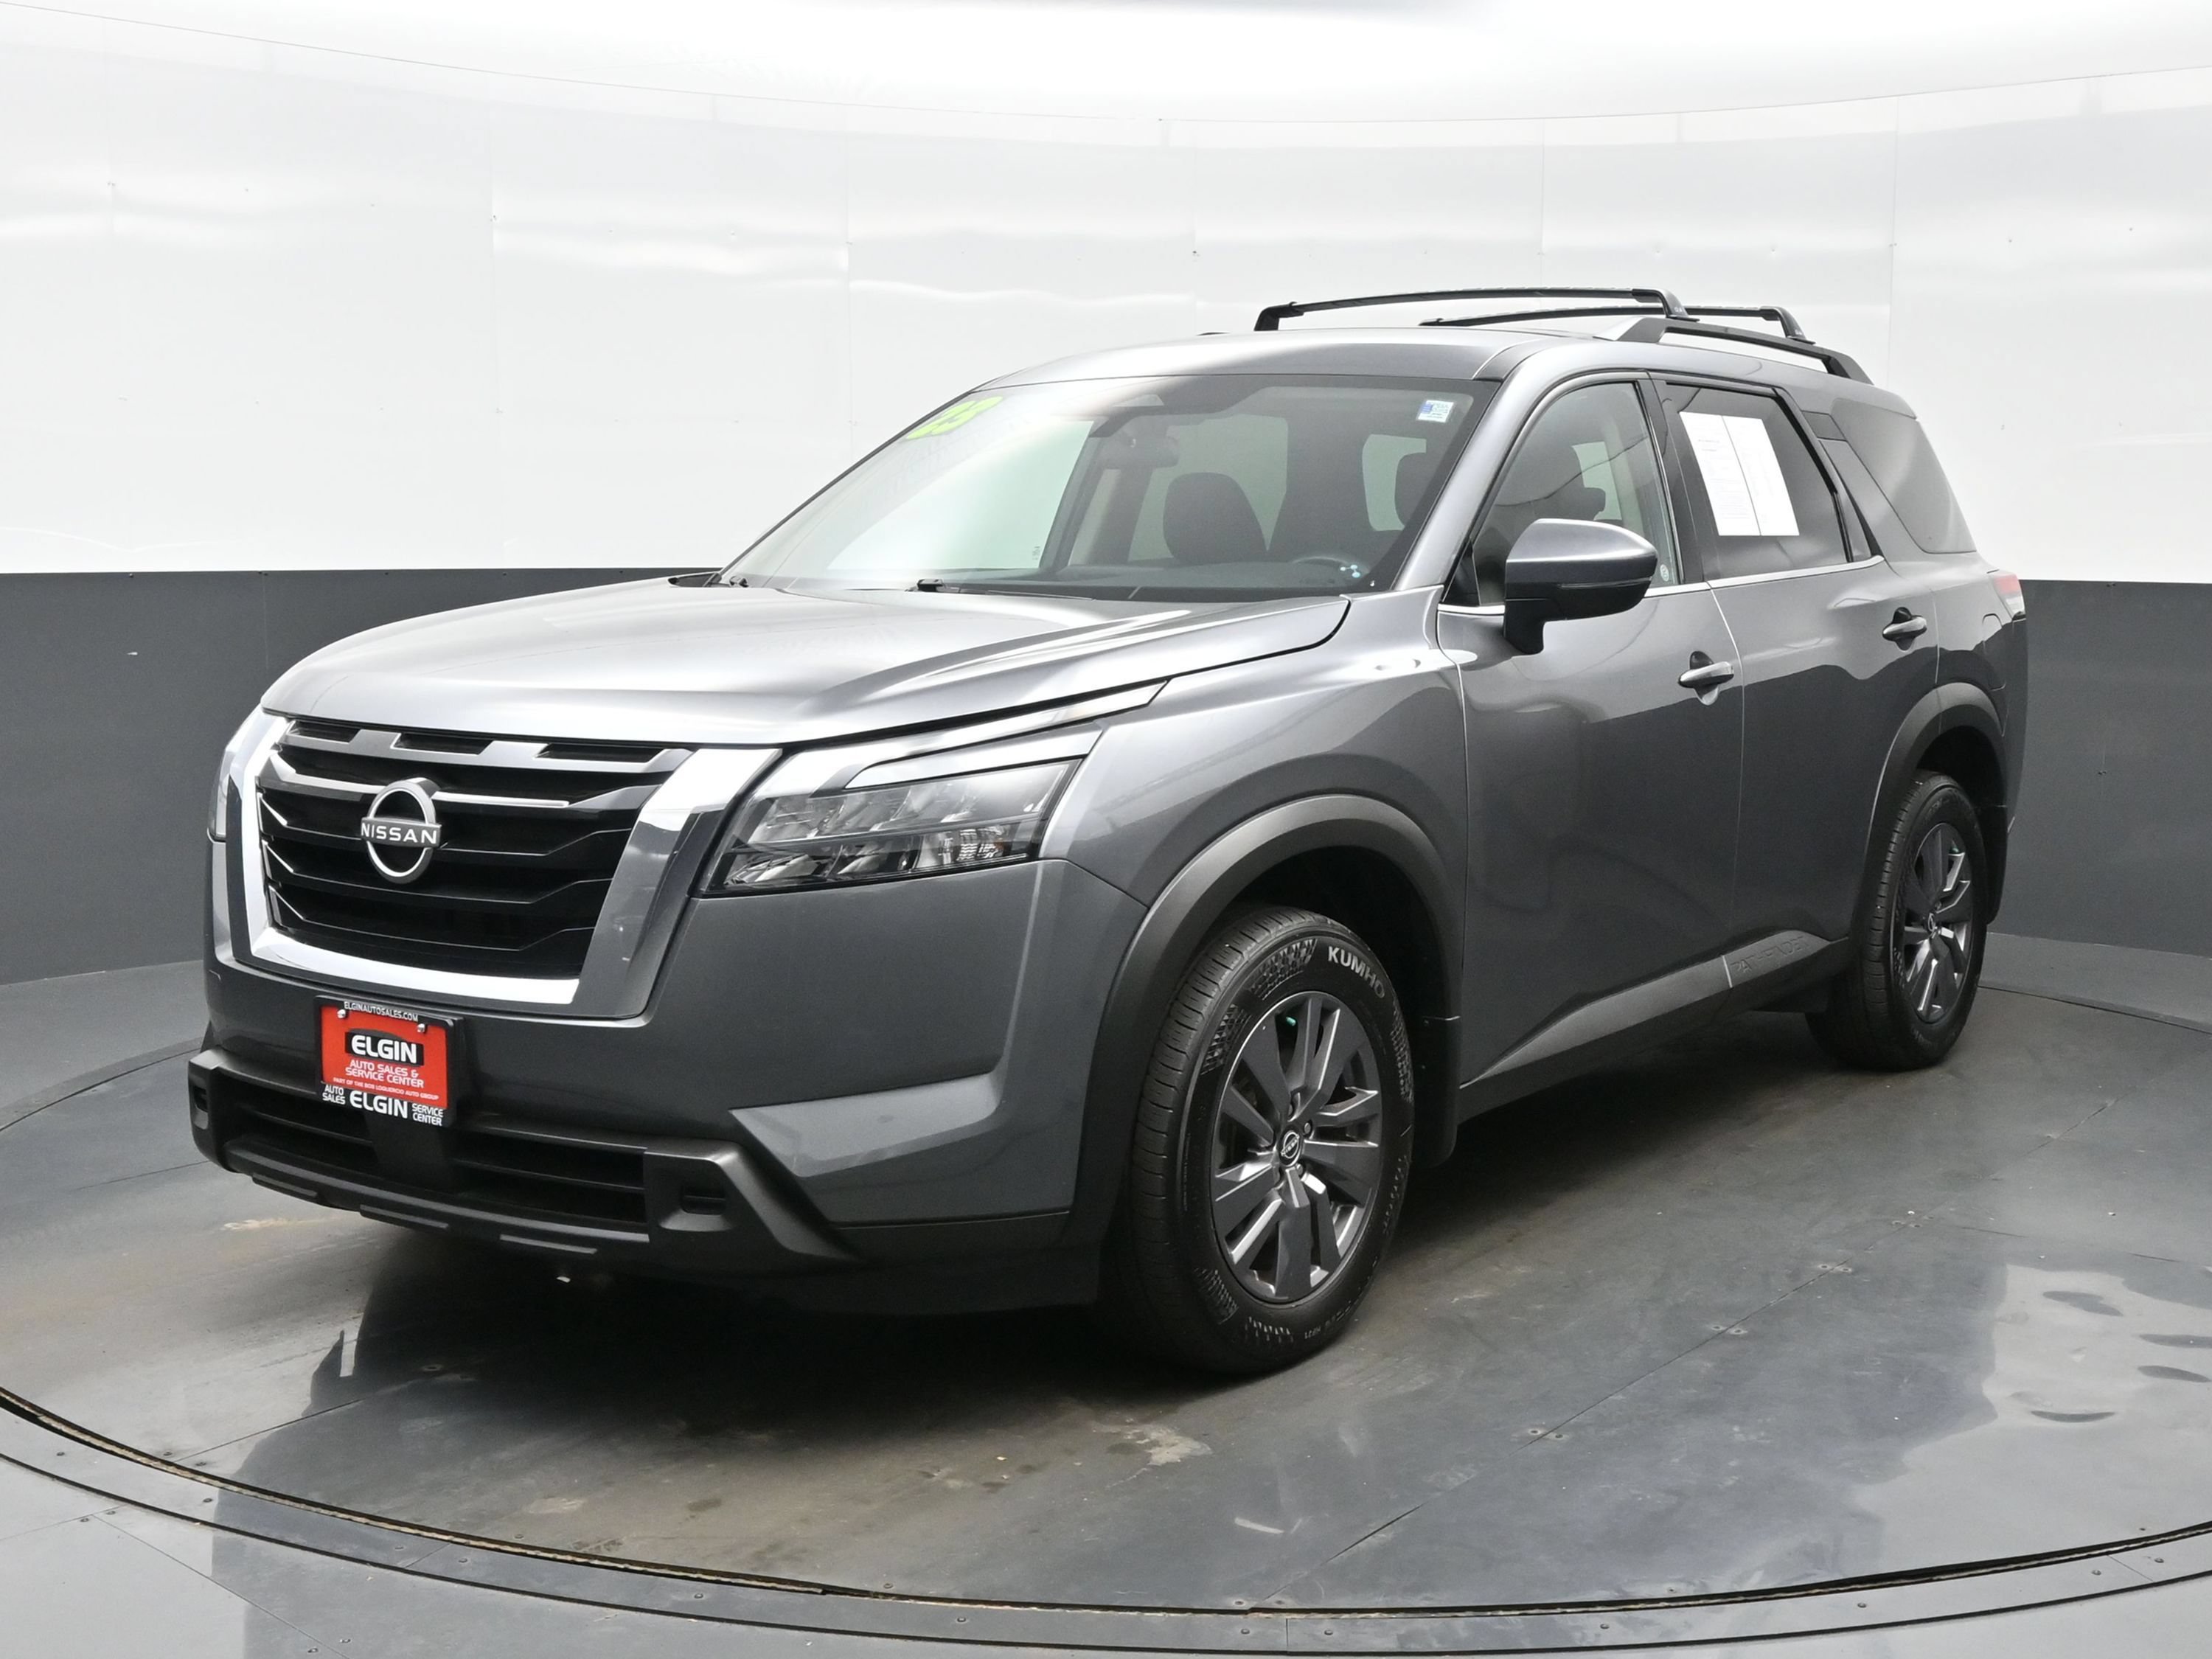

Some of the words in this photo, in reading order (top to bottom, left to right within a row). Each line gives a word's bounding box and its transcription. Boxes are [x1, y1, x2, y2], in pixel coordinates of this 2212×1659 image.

[361, 822, 437, 844] NISSAN
[1328, 946, 1385, 998] KUMHO
[344, 1001, 418, 1022] ELGINAUTOSALES.COM
[352, 1034, 417, 1064] ELGIN
[345, 1067, 384, 1082] SERVICE
[386, 1074, 424, 1088] CENTER
[349, 1060, 375, 1071] AUTO
[377, 1064, 408, 1077] SALES
[411, 1069, 419, 1078] &
[322, 1092, 346, 1105] SALES
[324, 1085, 344, 1096] AUTO
[349, 1090, 408, 1119] ELGIN
[411, 1103, 444, 1118] SERVICE
[413, 1112, 442, 1127] CENTER
